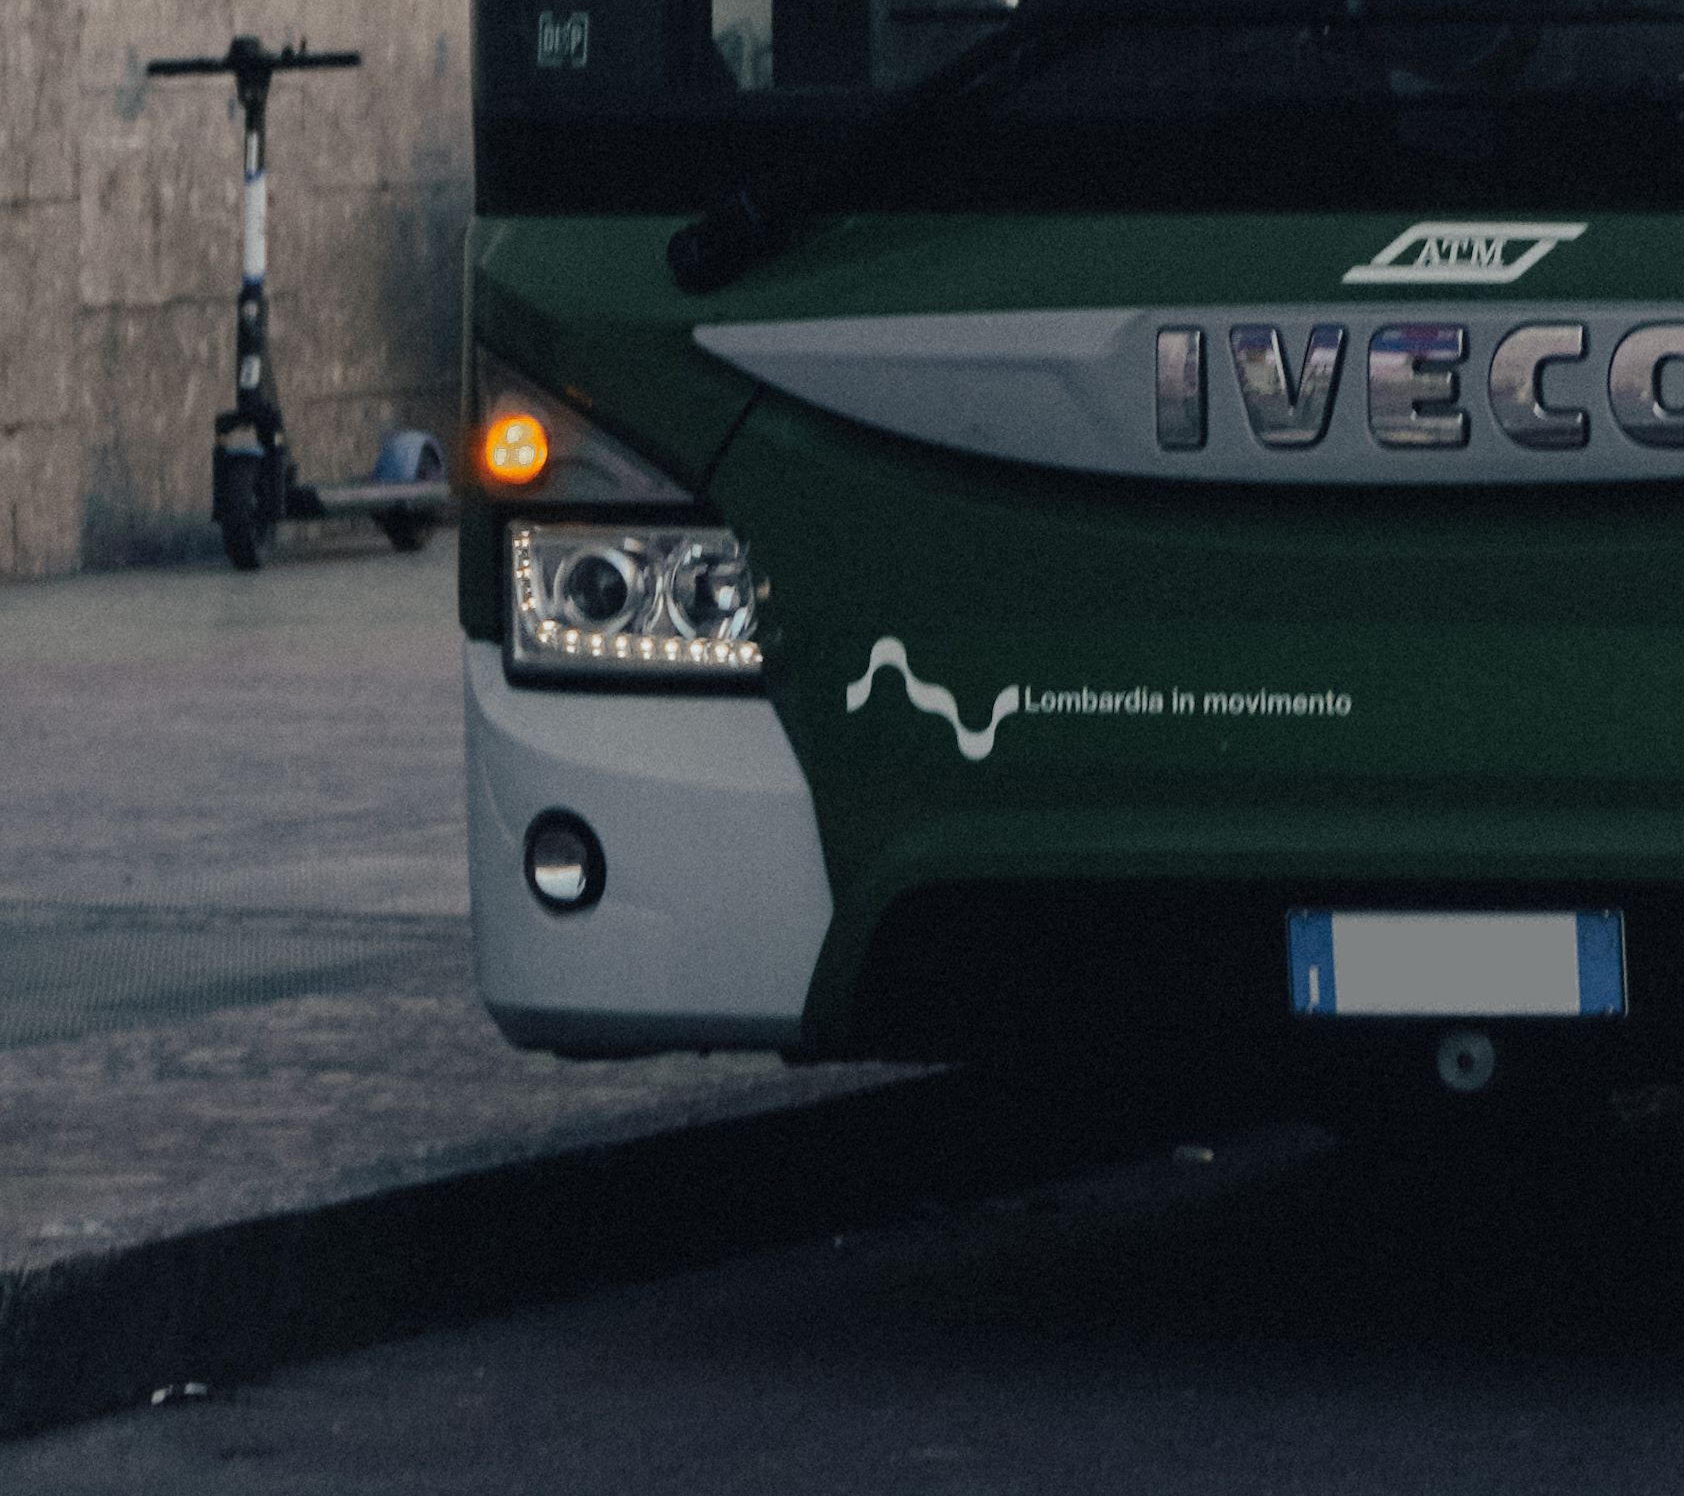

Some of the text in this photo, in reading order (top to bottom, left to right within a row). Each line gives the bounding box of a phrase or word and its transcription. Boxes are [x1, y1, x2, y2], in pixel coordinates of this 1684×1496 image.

[1412, 236, 1508, 269] ATM
[1025, 684, 1351, 718] Lombardia in movimento
